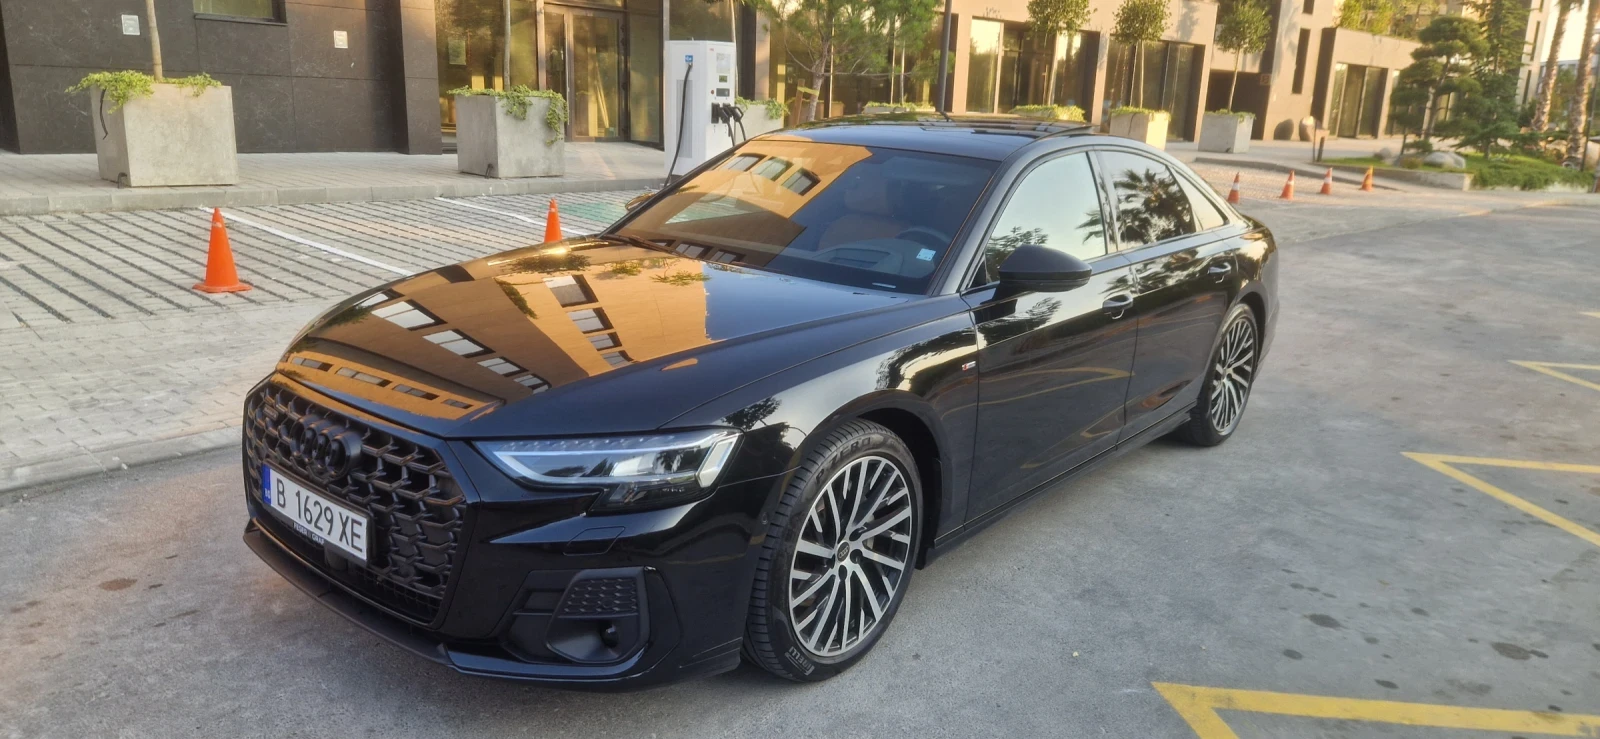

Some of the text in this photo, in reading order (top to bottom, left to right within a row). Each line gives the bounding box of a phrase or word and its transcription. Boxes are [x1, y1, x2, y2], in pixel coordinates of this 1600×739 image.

[829, 437, 871, 470] ZERO
[276, 478, 363, 553] B 1629 XE
[784, 646, 815, 676] PIRELLI
